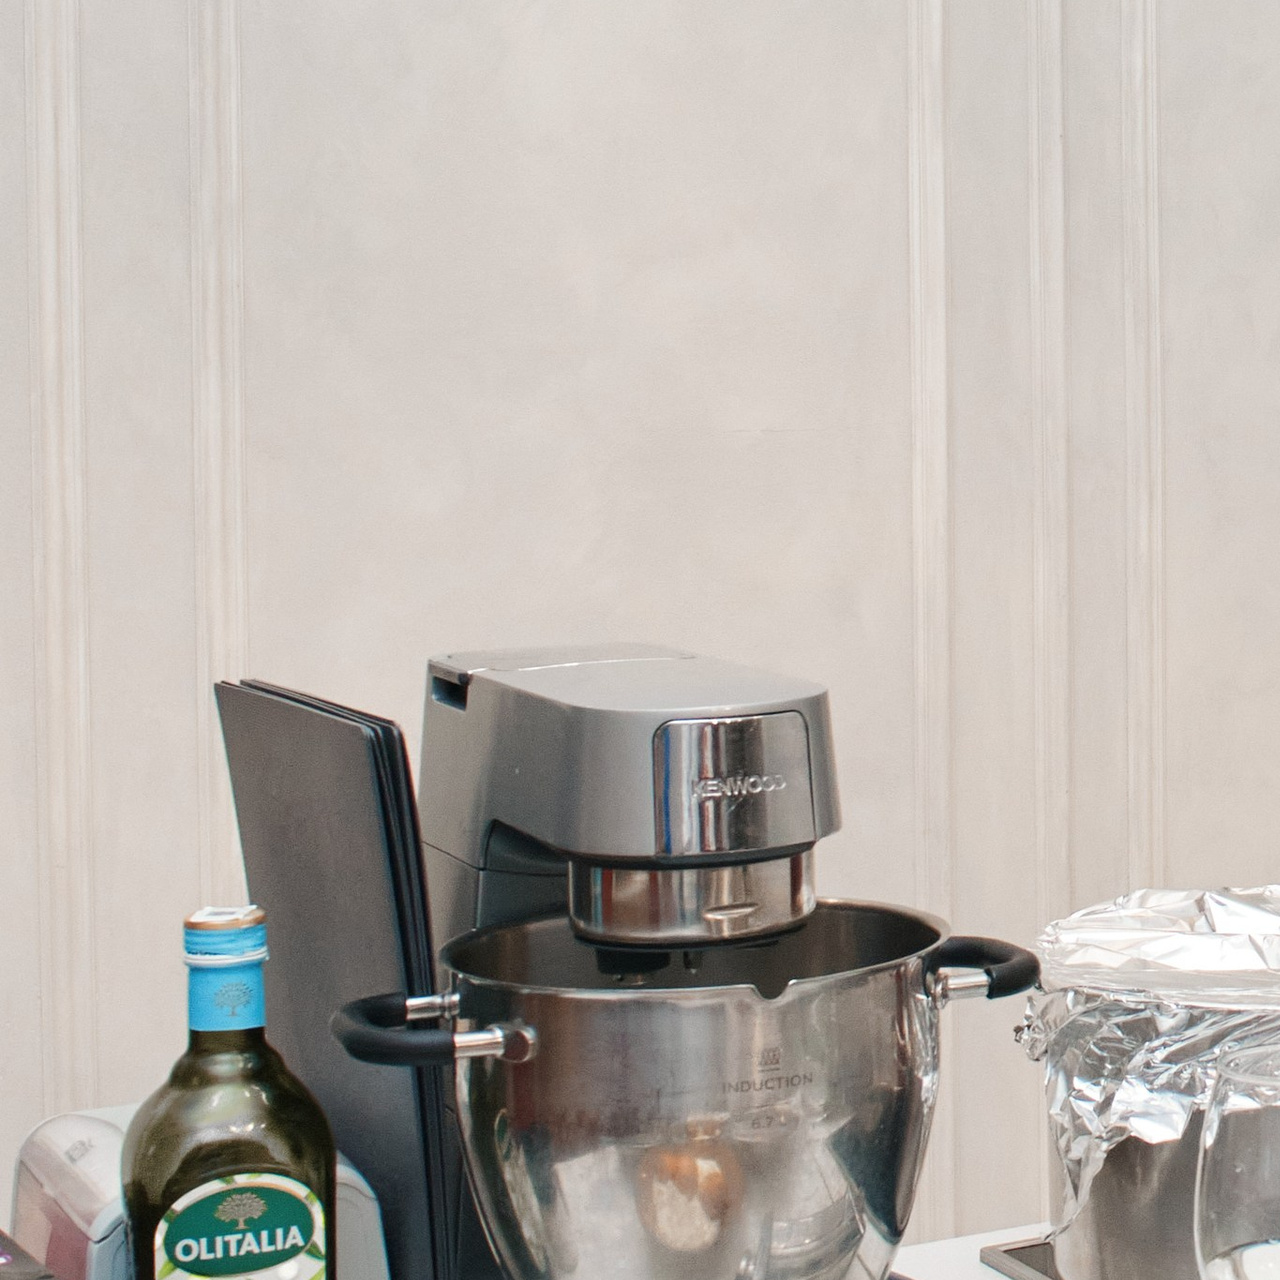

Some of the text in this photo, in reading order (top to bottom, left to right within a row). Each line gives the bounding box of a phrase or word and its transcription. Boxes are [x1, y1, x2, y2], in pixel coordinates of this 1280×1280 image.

[691, 774, 787, 797] KENWOOD
[721, 1073, 813, 1094] INDUCTION
[174, 1225, 305, 1262] OLITALIA
